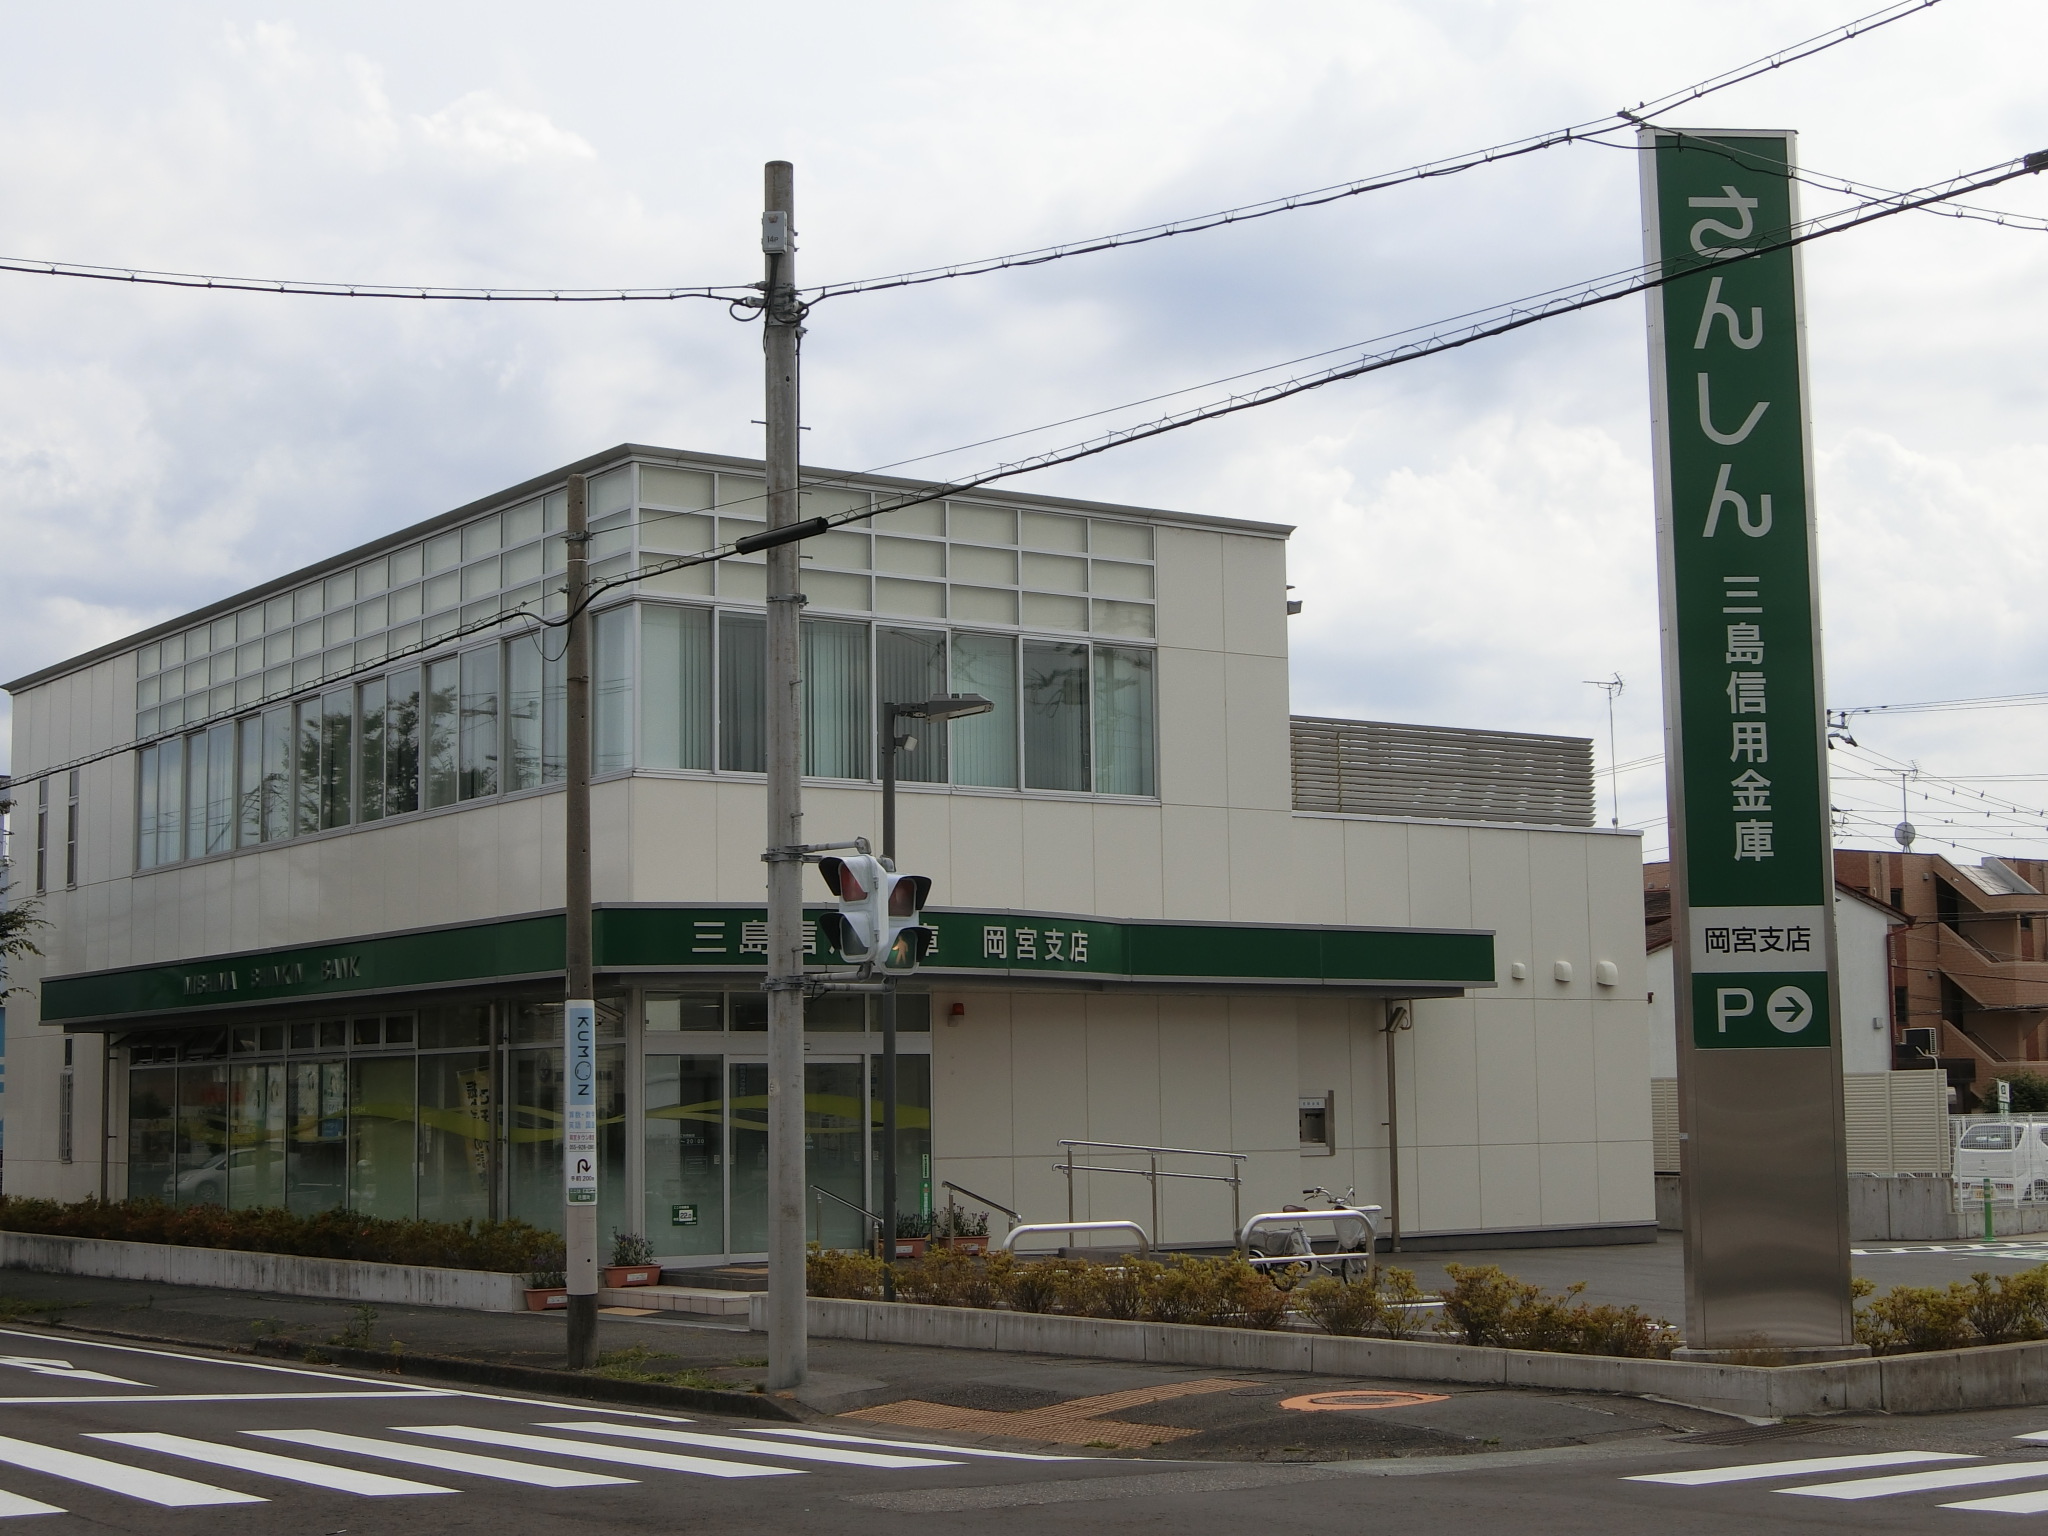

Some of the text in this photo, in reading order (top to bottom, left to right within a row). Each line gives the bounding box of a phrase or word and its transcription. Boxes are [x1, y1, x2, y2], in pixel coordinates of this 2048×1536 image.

[1688, 185, 1774, 539] さんしん
[1722, 574, 1775, 862] 三島信用金庫
[982, 924, 1089, 964] 岡宮支店
[1704, 925, 1811, 954] 岡宮支店
[320, 956, 361, 981] BANK
[1716, 987, 1755, 1033] P
[574, 1016, 592, 1096] KUMON
